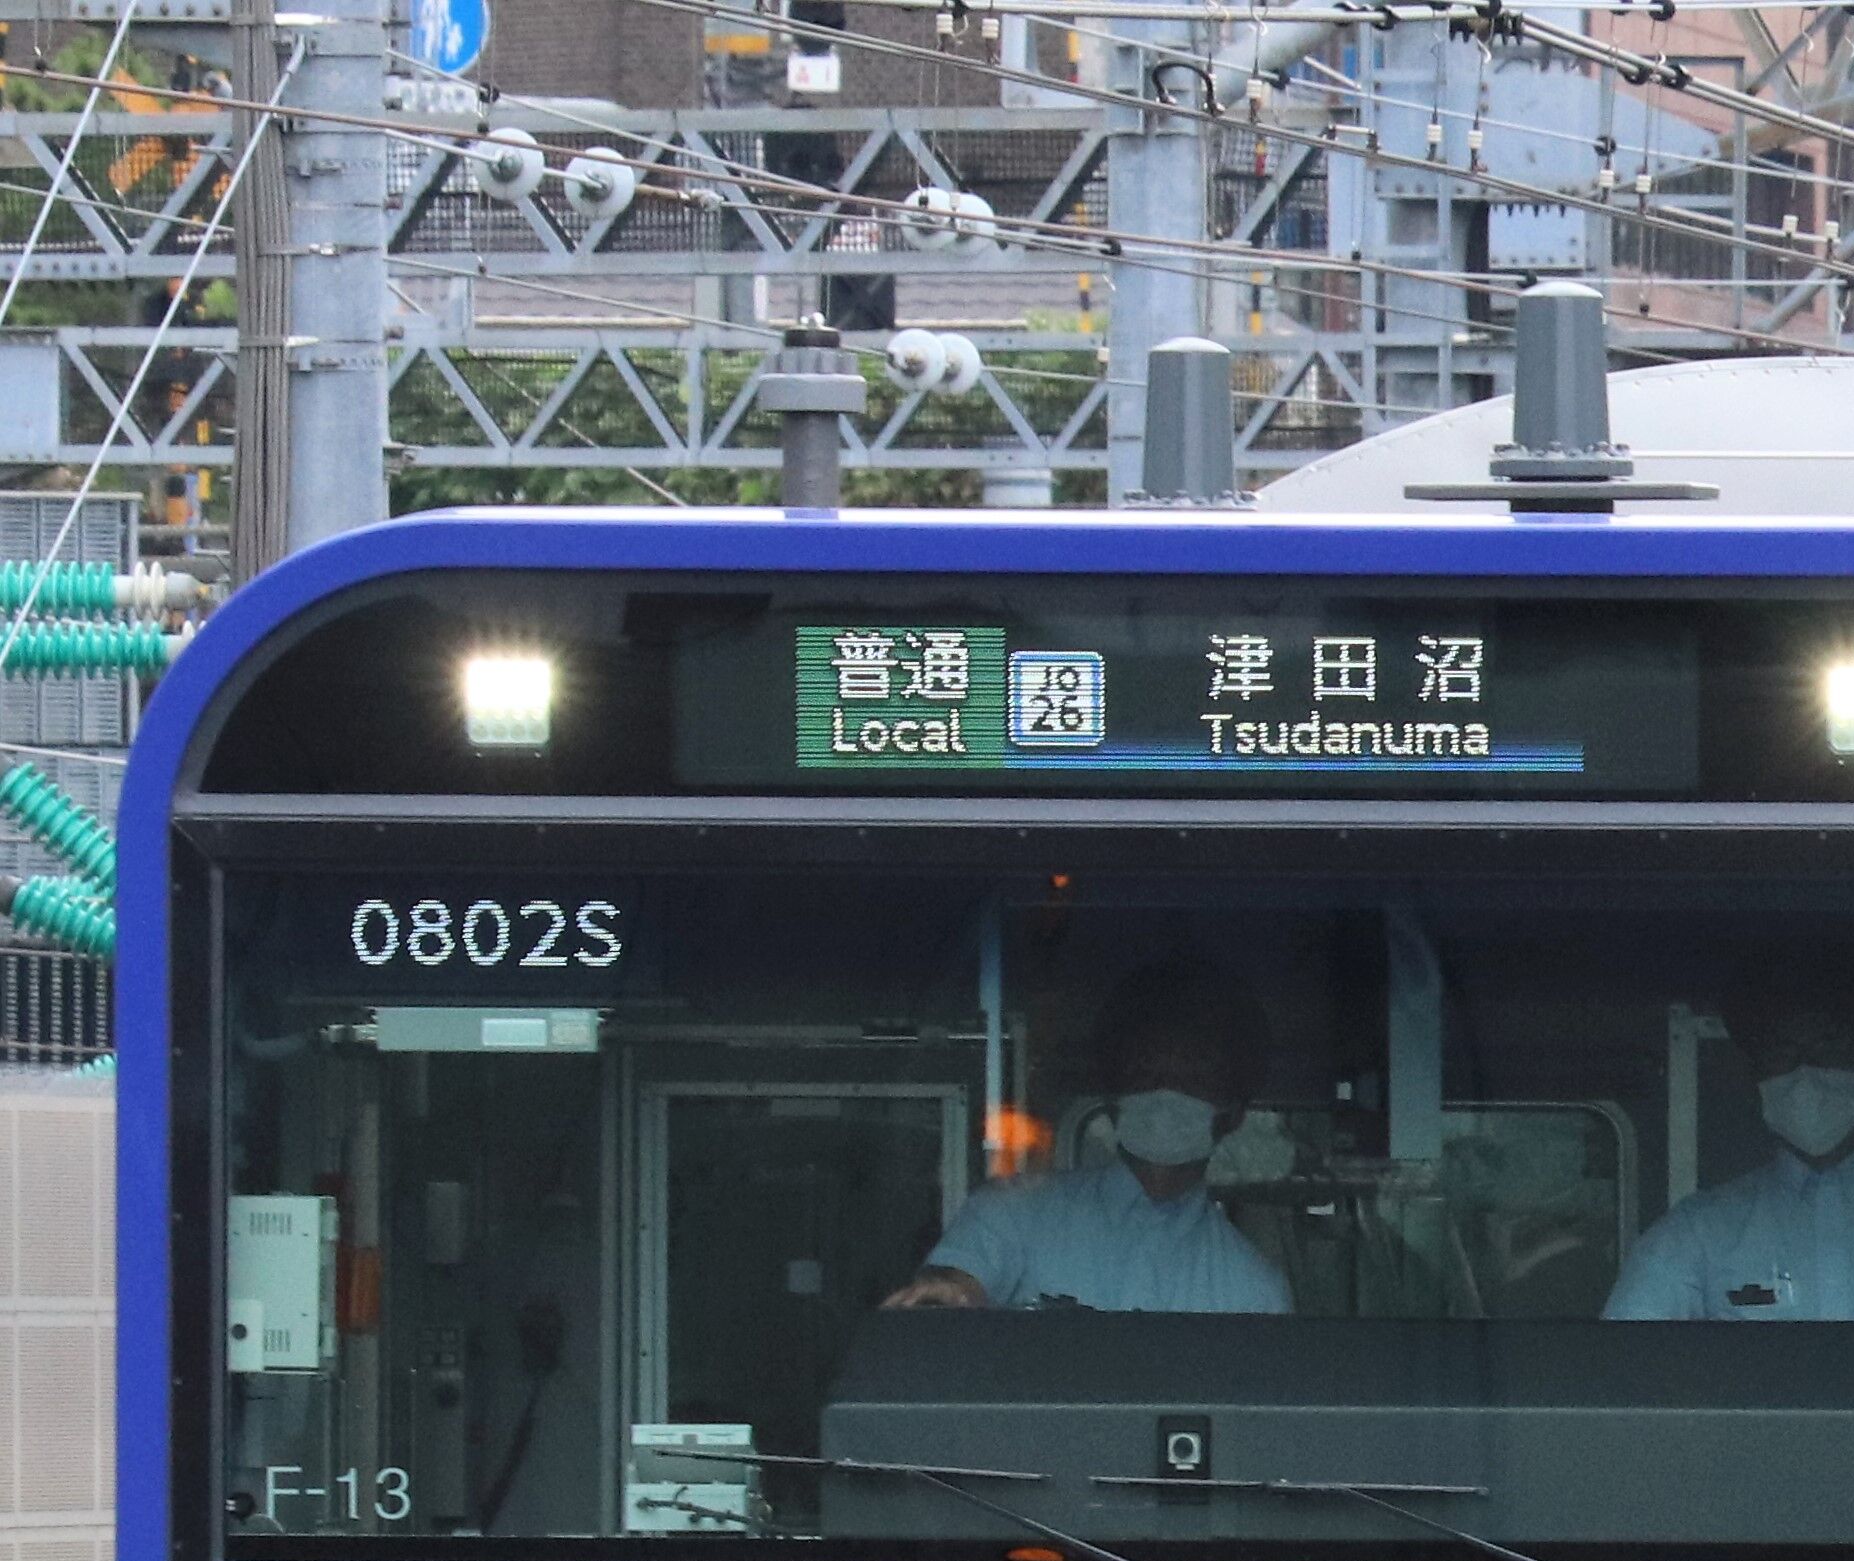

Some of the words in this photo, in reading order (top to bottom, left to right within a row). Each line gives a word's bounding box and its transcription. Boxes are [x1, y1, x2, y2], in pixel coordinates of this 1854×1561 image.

[831, 630, 970, 700] 普通
[1041, 665, 1082, 694] JO
[1205, 633, 1484, 703] 津田沼
[832, 707, 968, 753] Local
[1029, 694, 1084, 732] 26
[1200, 709, 1491, 756] Tsudanuma
[349, 898, 624, 968] 0802S
[264, 1465, 413, 1522] F-13
